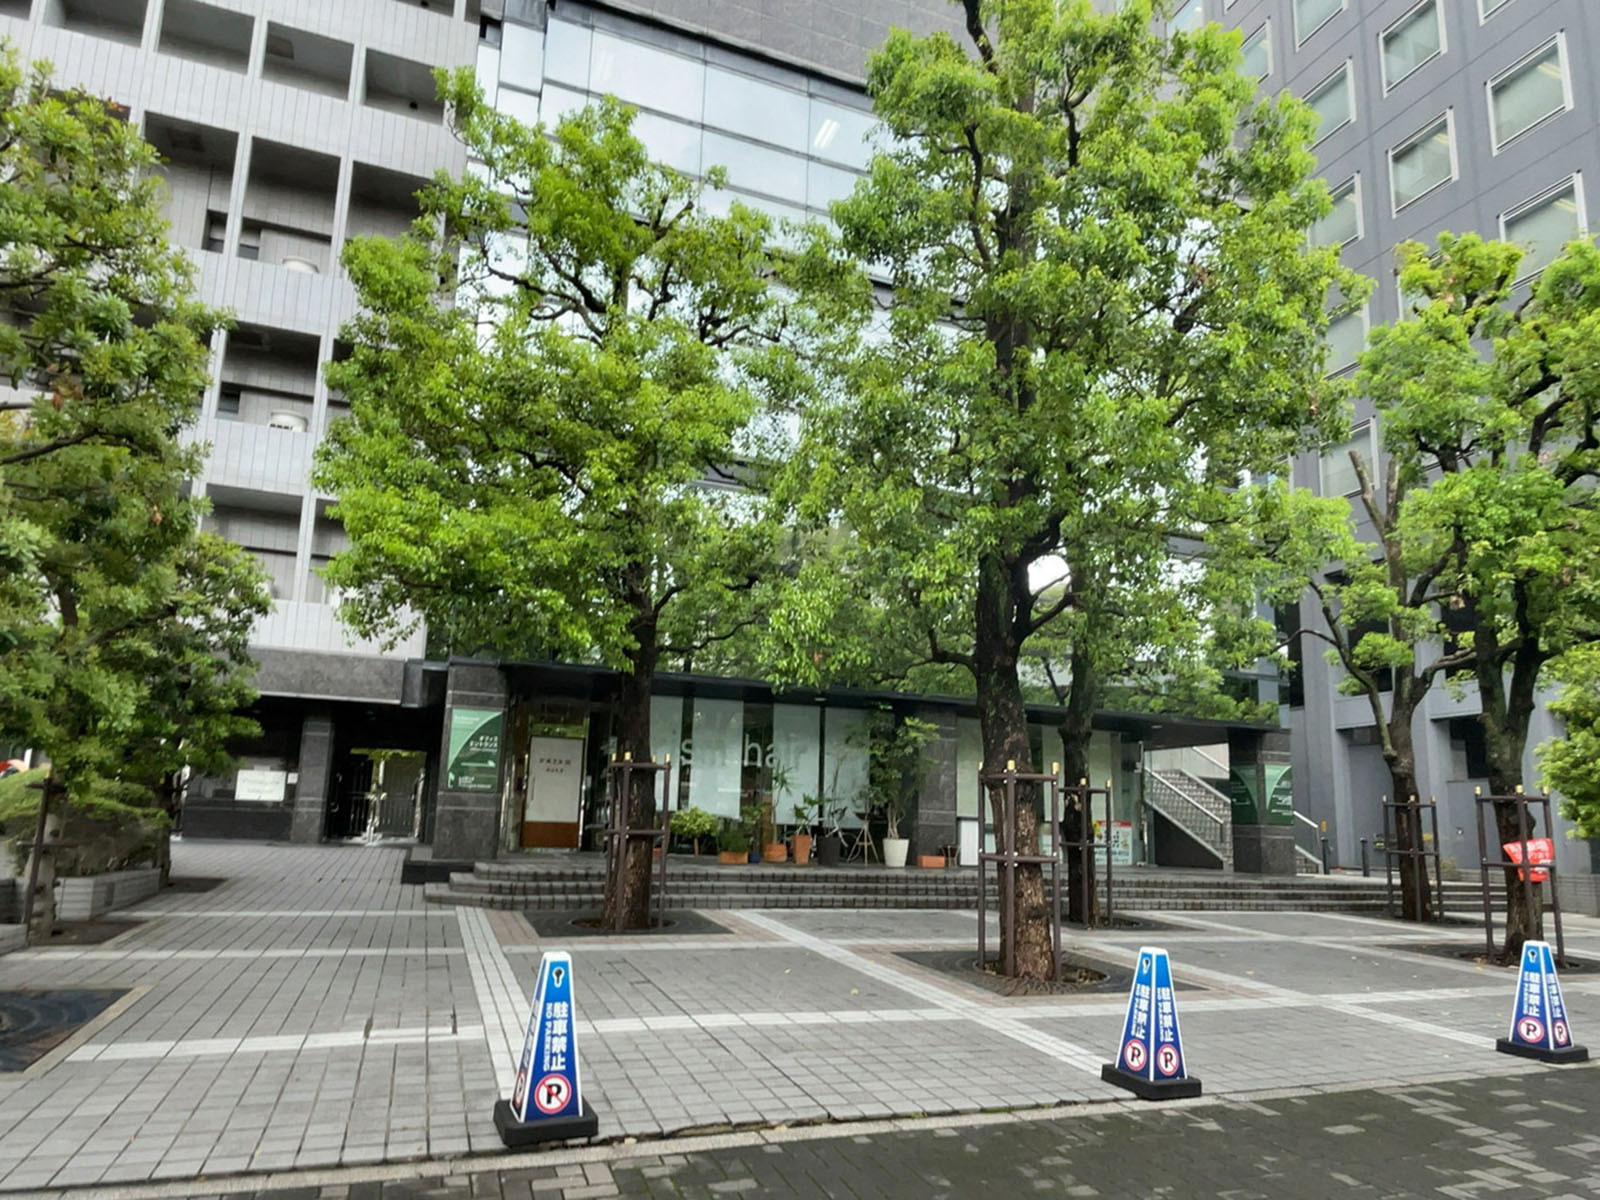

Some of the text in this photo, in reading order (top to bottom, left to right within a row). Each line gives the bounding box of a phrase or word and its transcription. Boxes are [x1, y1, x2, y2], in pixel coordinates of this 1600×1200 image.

[545, 1002, 553, 1019] NO
[550, 1001, 569, 1071] 駐車禁止
